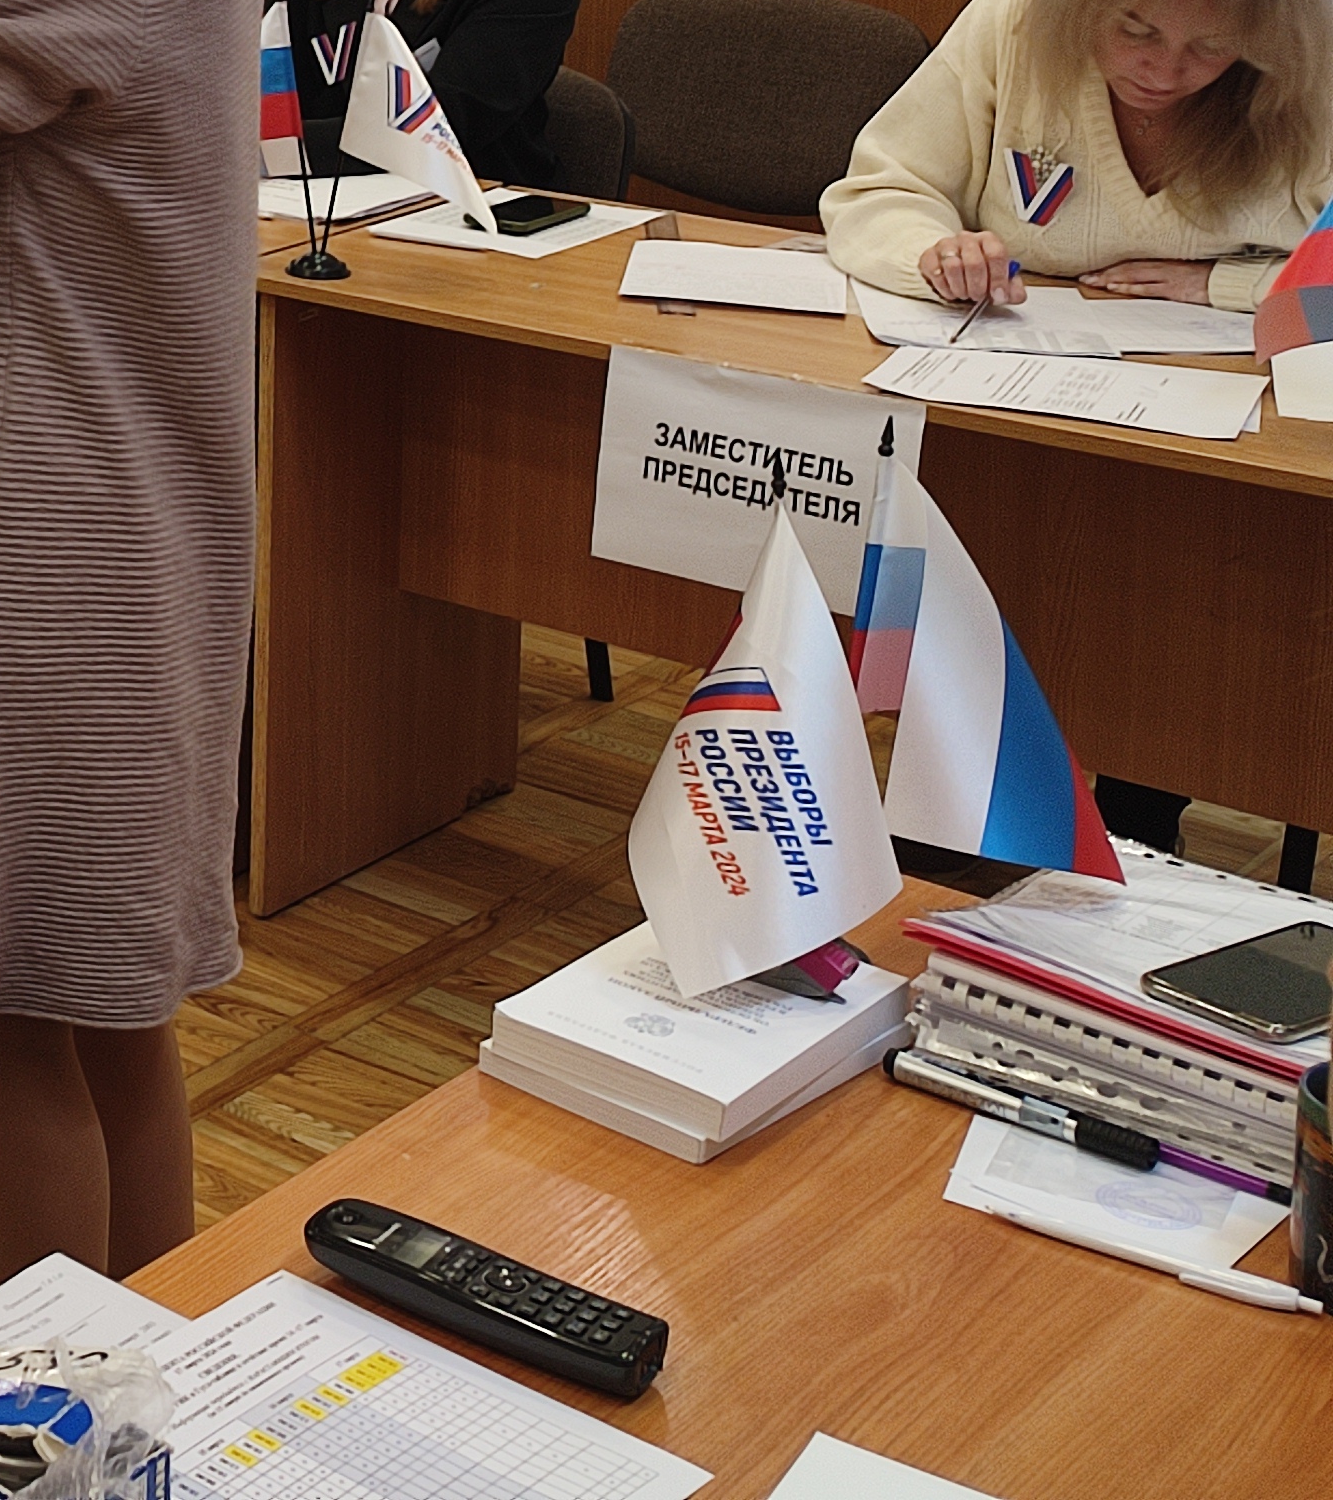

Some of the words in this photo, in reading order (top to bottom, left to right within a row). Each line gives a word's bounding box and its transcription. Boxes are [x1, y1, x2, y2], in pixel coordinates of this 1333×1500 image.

[642, 456, 861, 526] ПРЕДСЕДТЕЛЯ
[654, 422, 854, 486] ЗАМЕСТИТЕЛЬ
[695, 729, 760, 832] РОССИИ
[727, 729, 819, 897] ПРЕЗИДЕНТА
[765, 730, 833, 845] ВЫБОРЫ
[683, 782, 728, 845] МАРТА
[709, 850, 750, 896] 2024
